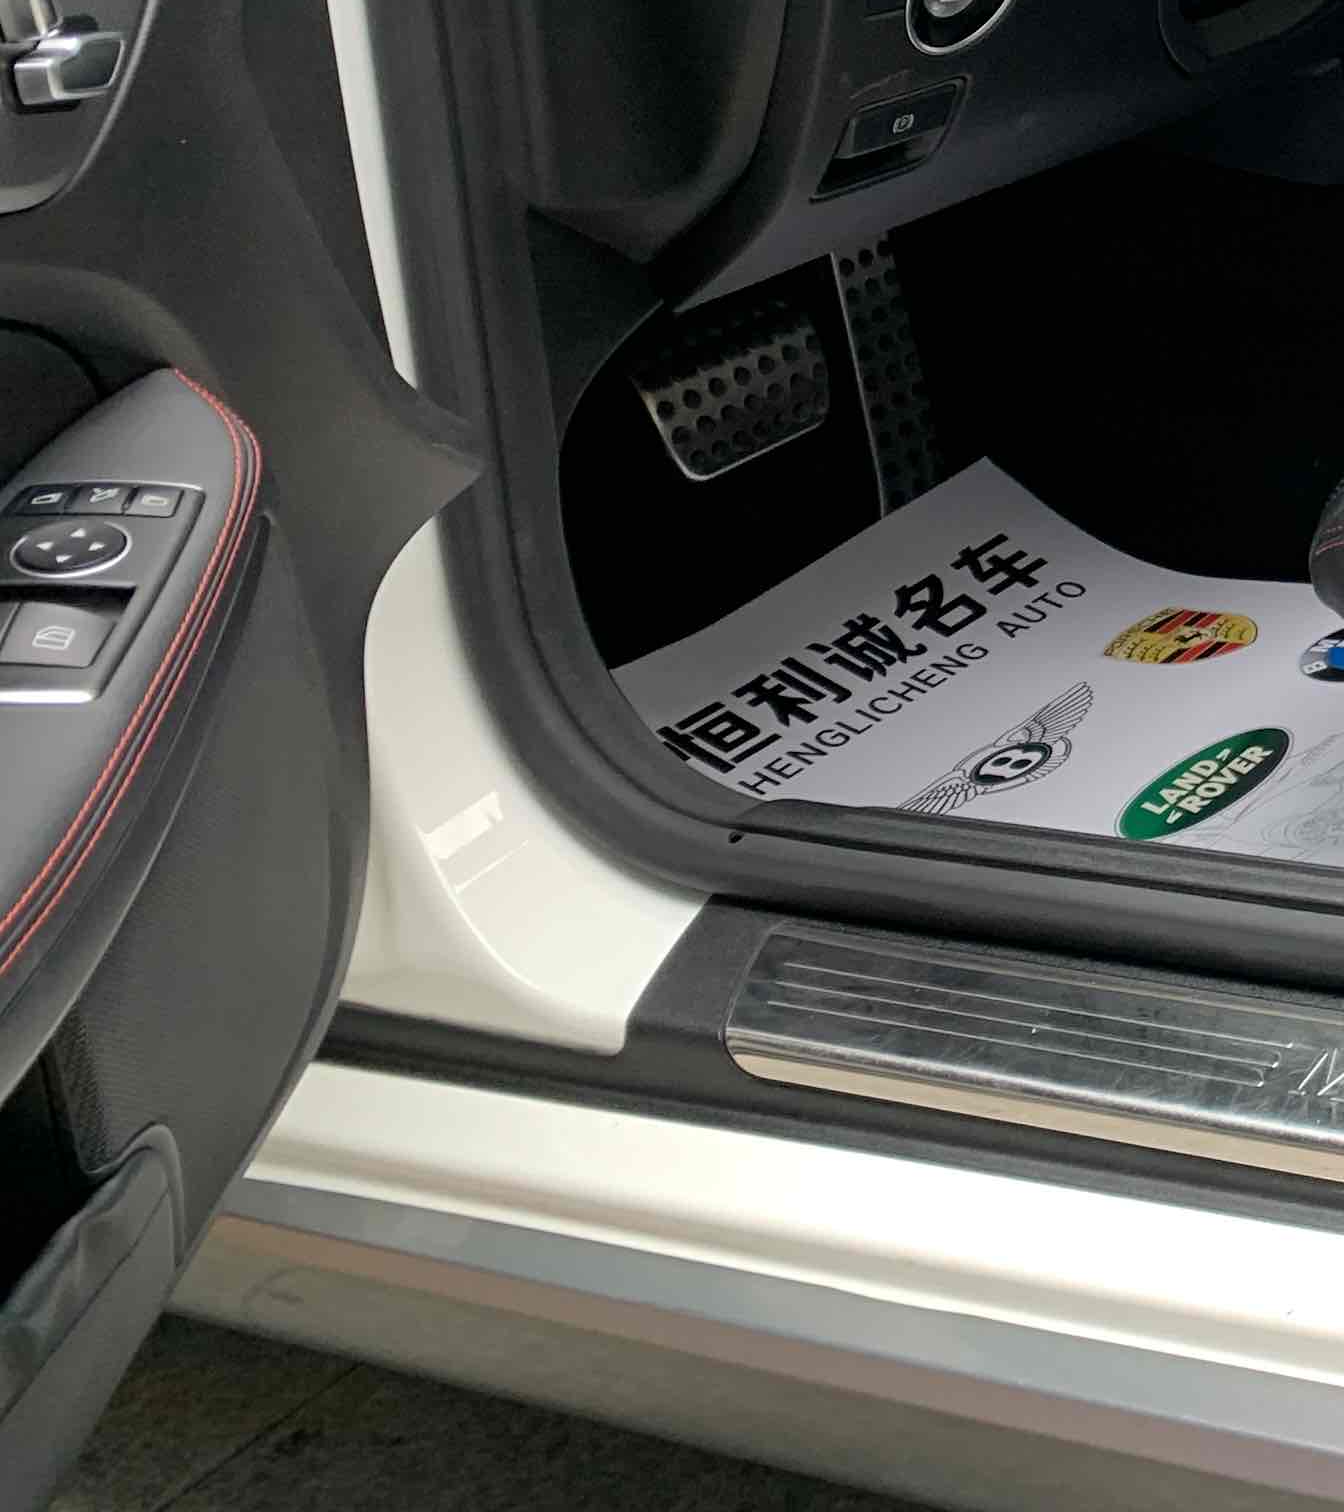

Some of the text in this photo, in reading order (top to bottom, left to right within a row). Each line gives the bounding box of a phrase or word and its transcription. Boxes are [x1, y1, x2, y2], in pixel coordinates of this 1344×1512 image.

[657, 533, 1048, 773] 恒利诚名车
[739, 581, 1086, 794] HENGLICHENG AUTO
[1141, 759, 1218, 816] LAND
[1177, 745, 1274, 813] ROVER
